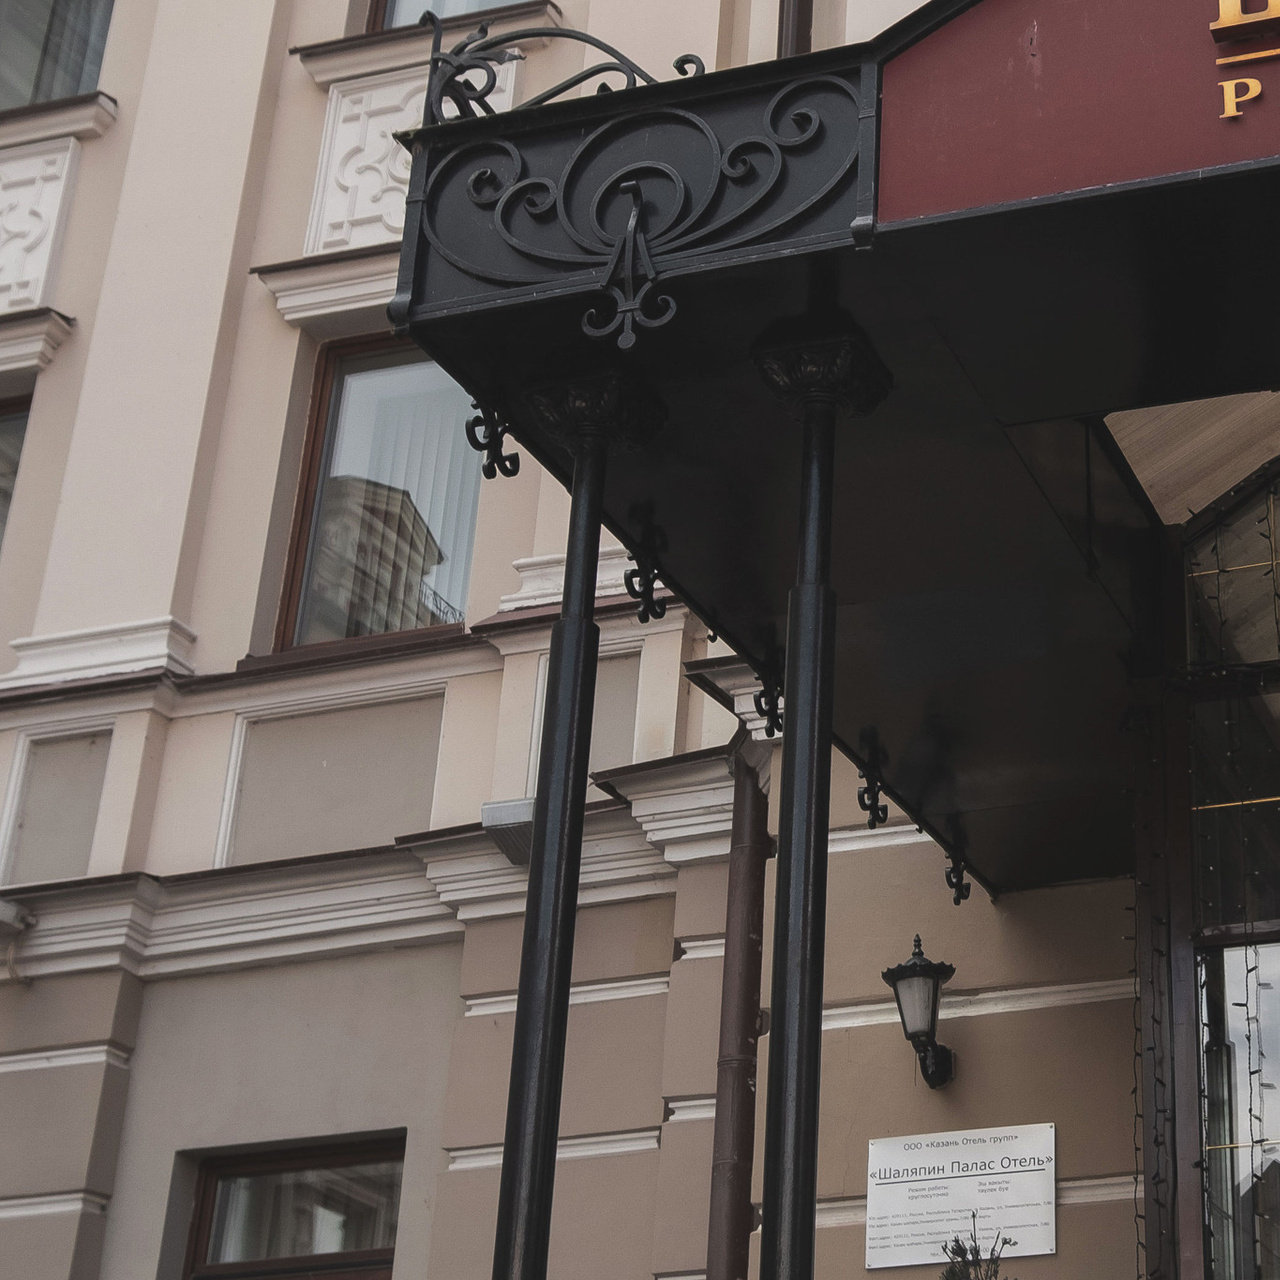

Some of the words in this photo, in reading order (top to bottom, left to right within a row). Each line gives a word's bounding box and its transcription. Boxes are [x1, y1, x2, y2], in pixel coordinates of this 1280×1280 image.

[903, 1142, 923, 1151] ООО
[925, 1140, 960, 1149] «Казань
[961, 1136, 987, 1146] Отель
[989, 1135, 1019, 1144] групп»
[869, 1163, 945, 1181] «Шаляпин
[950, 1158, 995, 1174] Палас
[1000, 1155, 1053, 1169] Отель»
